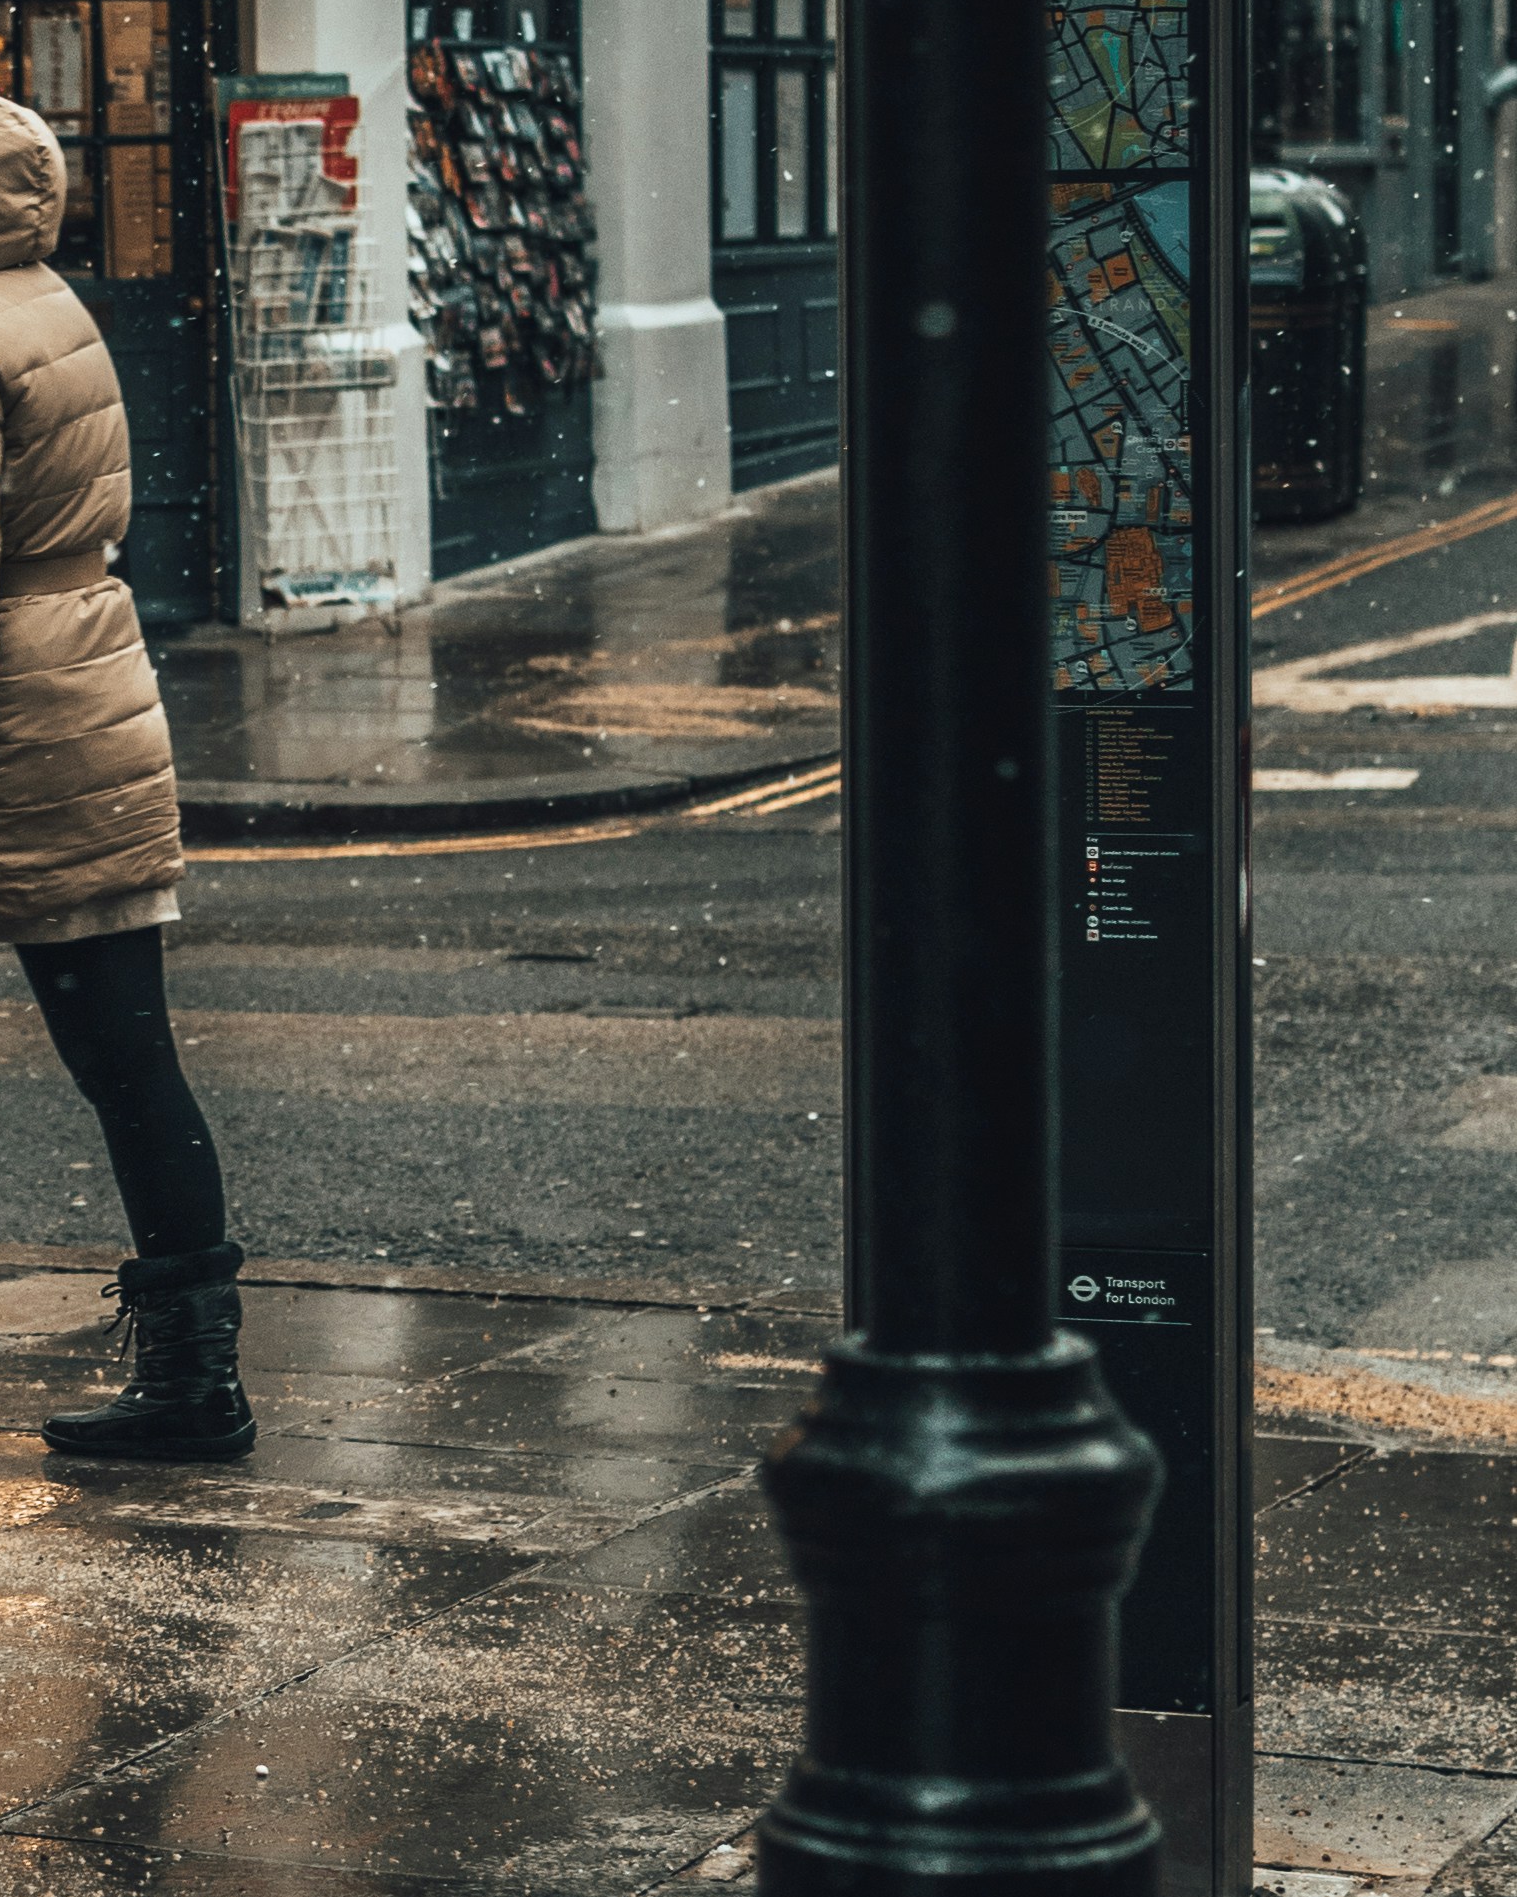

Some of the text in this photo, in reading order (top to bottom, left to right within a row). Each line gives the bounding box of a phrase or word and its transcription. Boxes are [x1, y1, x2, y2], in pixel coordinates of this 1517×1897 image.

[1105, 1276, 1166, 1290] Transport
[1106, 1292, 1175, 1305] for London
